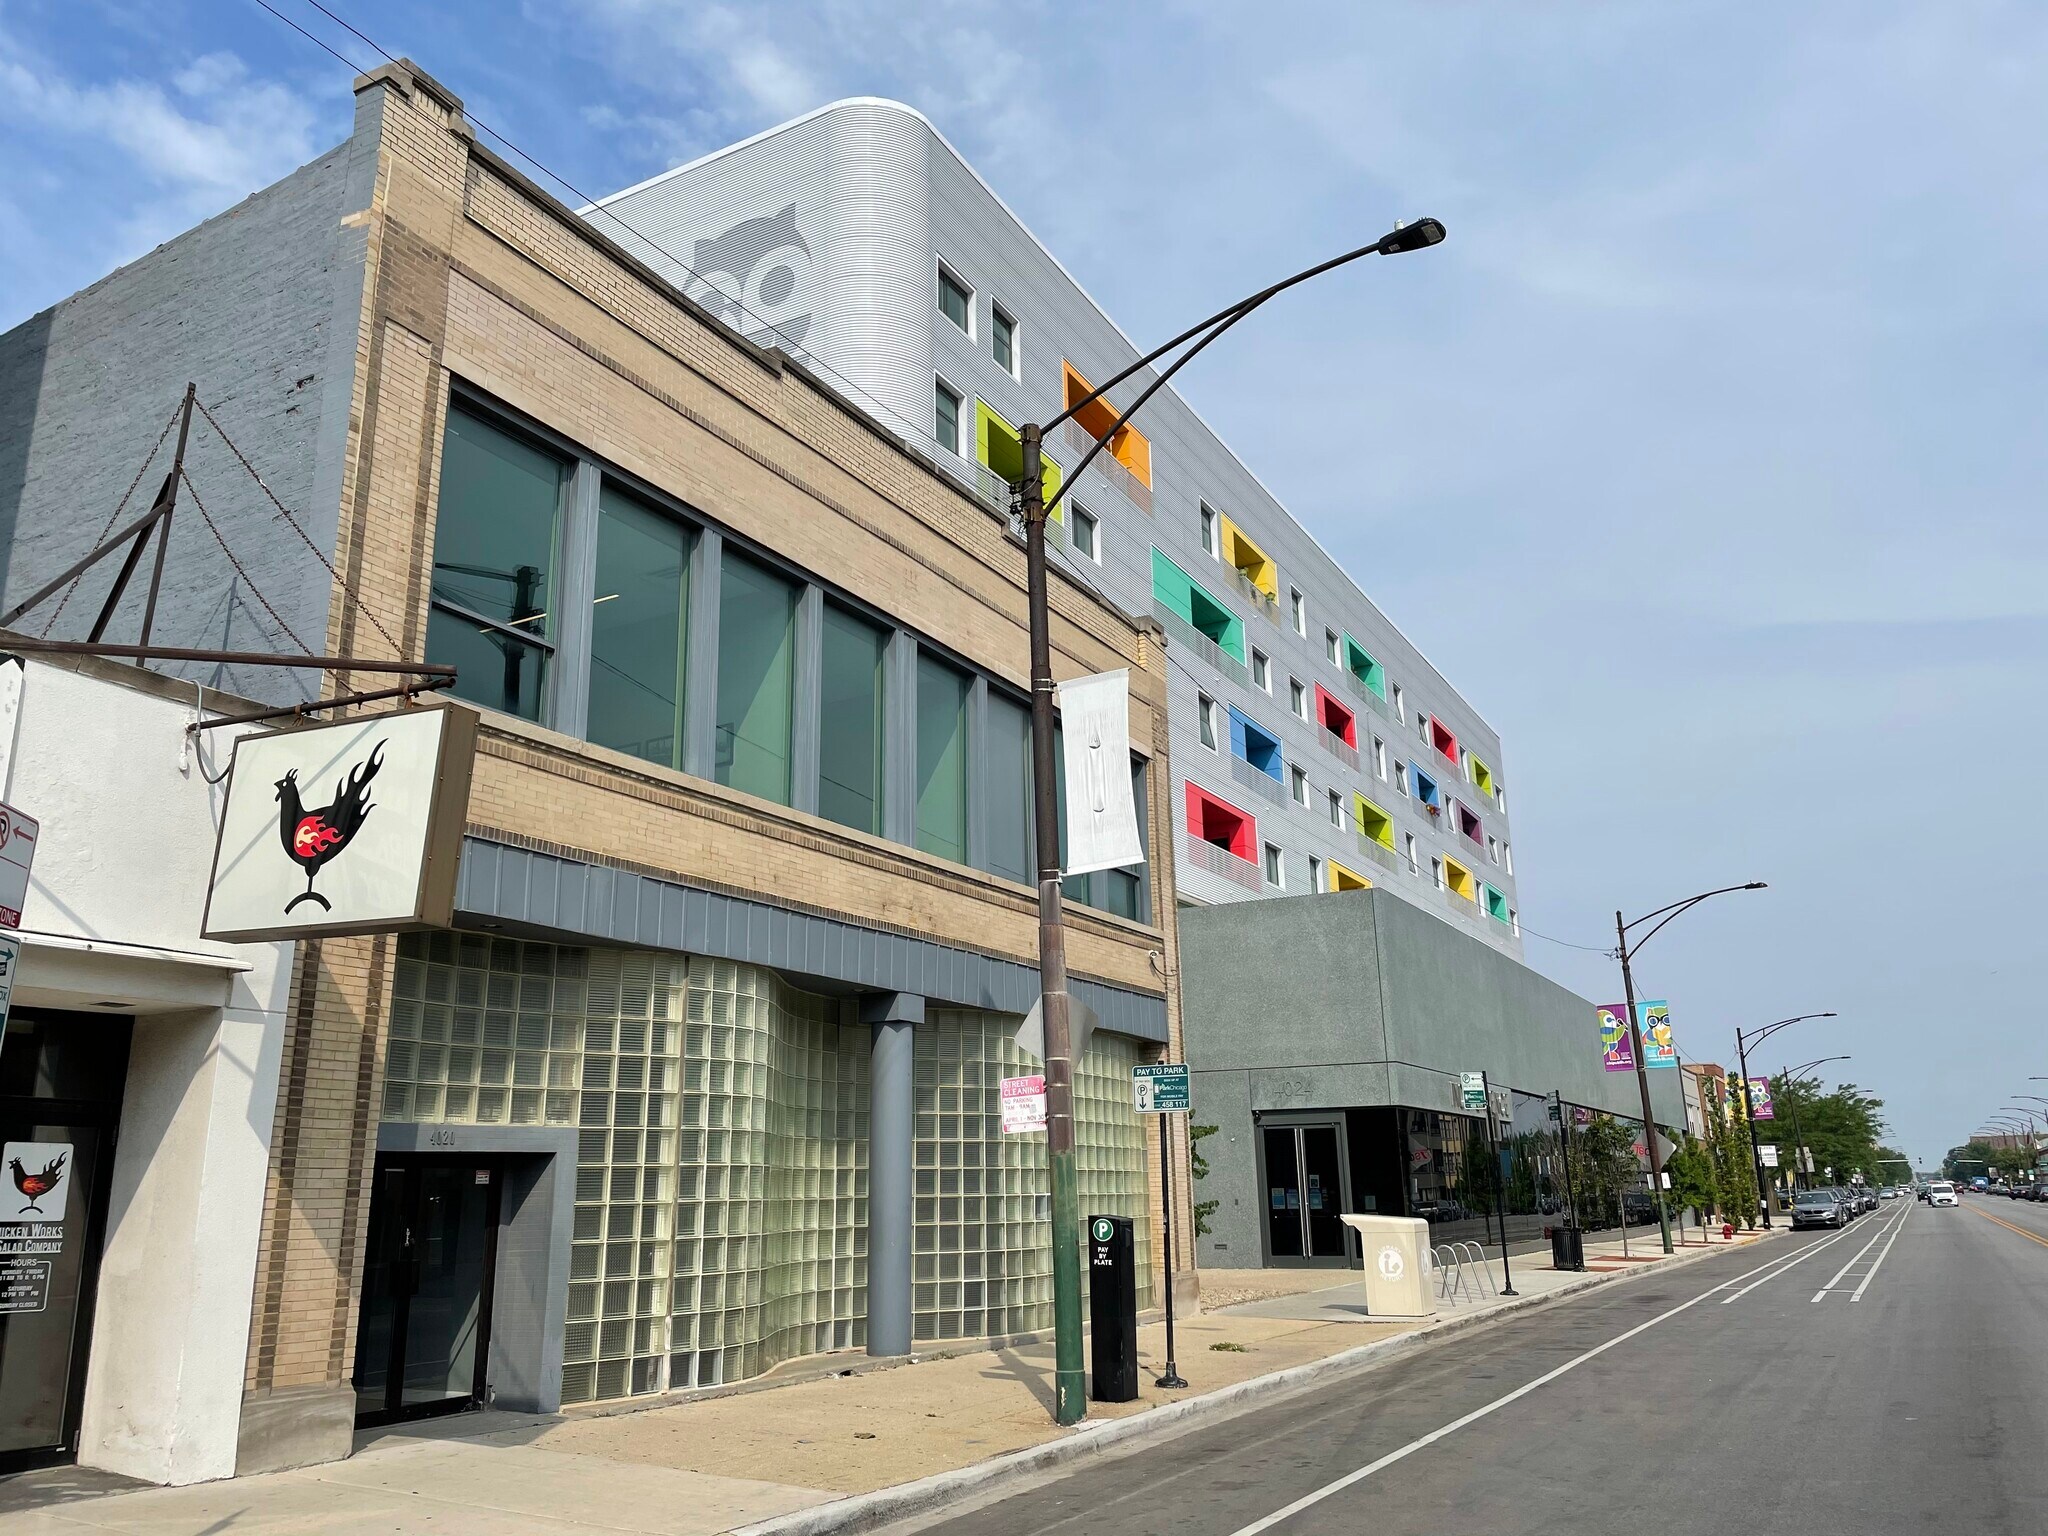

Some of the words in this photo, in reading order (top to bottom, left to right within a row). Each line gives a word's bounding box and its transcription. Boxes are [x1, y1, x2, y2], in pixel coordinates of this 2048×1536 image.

[1136, 1068, 1150, 1076] PAY
[1152, 1067, 1162, 1075] TO
[1163, 1066, 1184, 1075] PARK
[1003, 1079, 1029, 1088] STREET
[1003, 1086, 1040, 1096] CLEANING
[1013, 1096, 1034, 1104] PARKING
[430, 1130, 456, 1146] 4020
[31, 1223, 63, 1237] WORKS
[1099, 1222, 1108, 1238] P
[25, 1239, 63, 1251] COMPANY
[10, 1258, 37, 1267] HOURS
